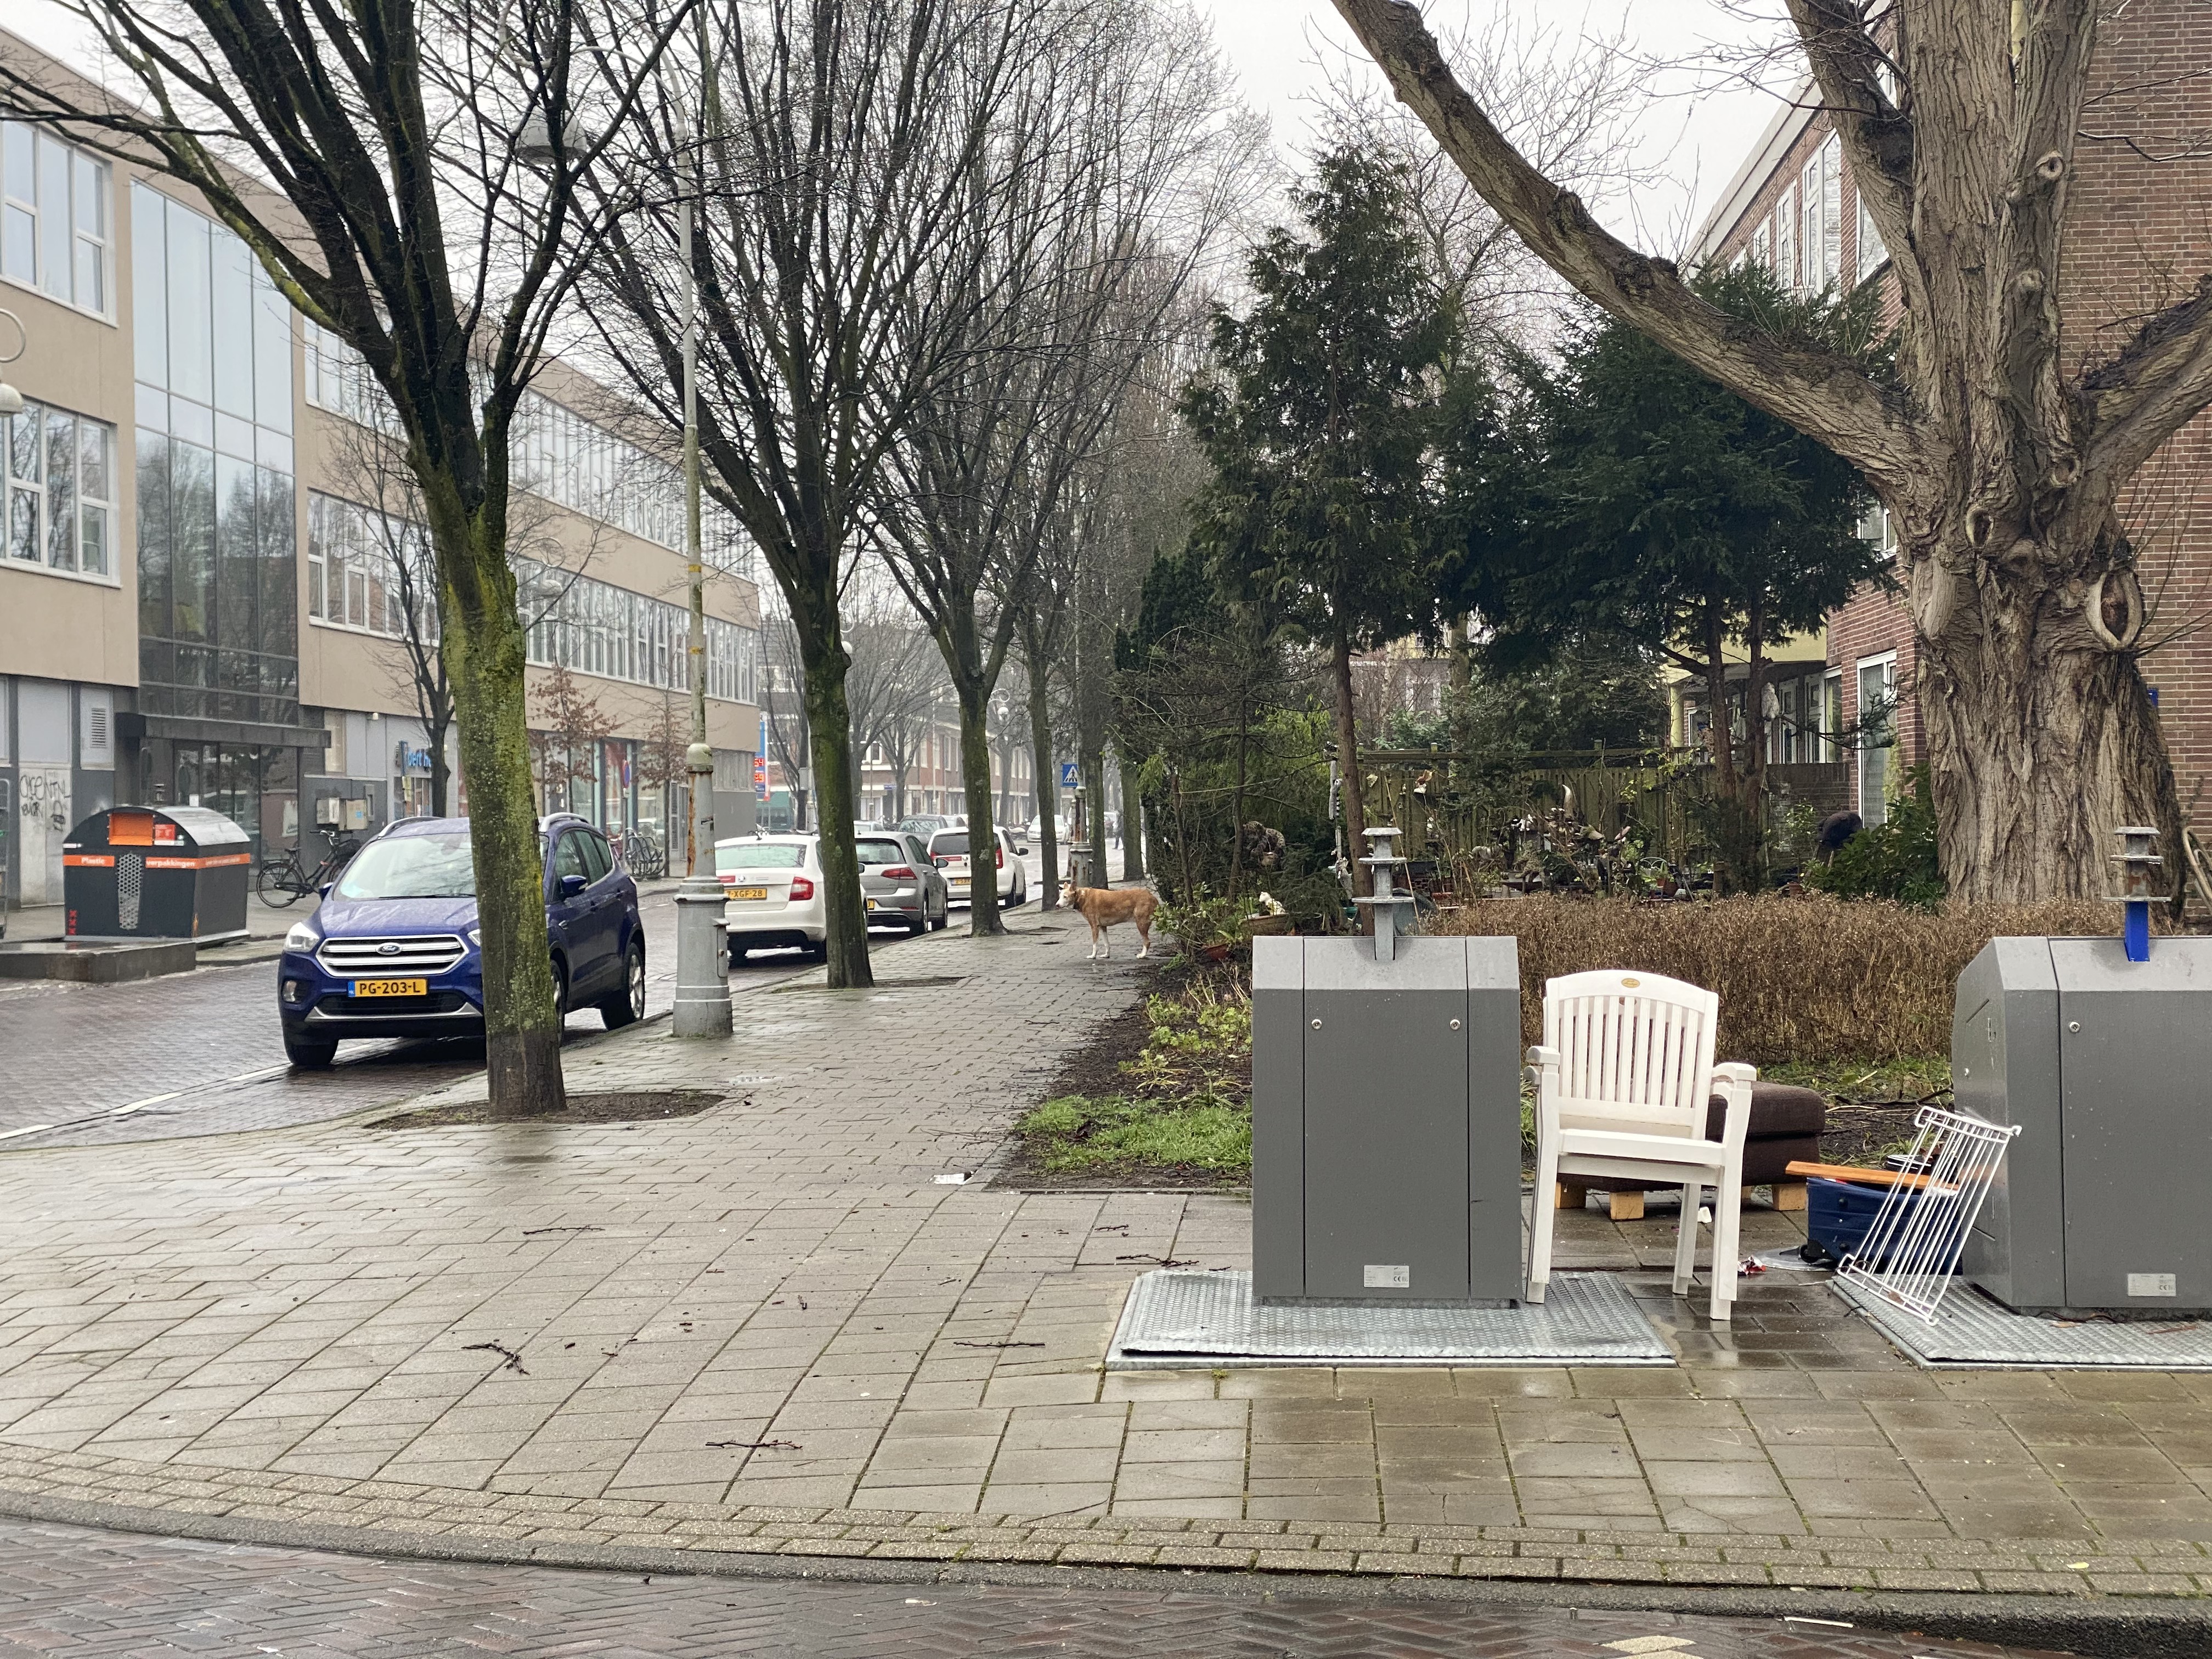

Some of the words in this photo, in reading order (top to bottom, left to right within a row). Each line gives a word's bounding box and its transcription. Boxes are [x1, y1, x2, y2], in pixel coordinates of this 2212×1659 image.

[81, 856, 105, 865] Plastic
[146, 859, 196, 868] verpakkingen
[359, 981, 421, 995] PG-203-L
